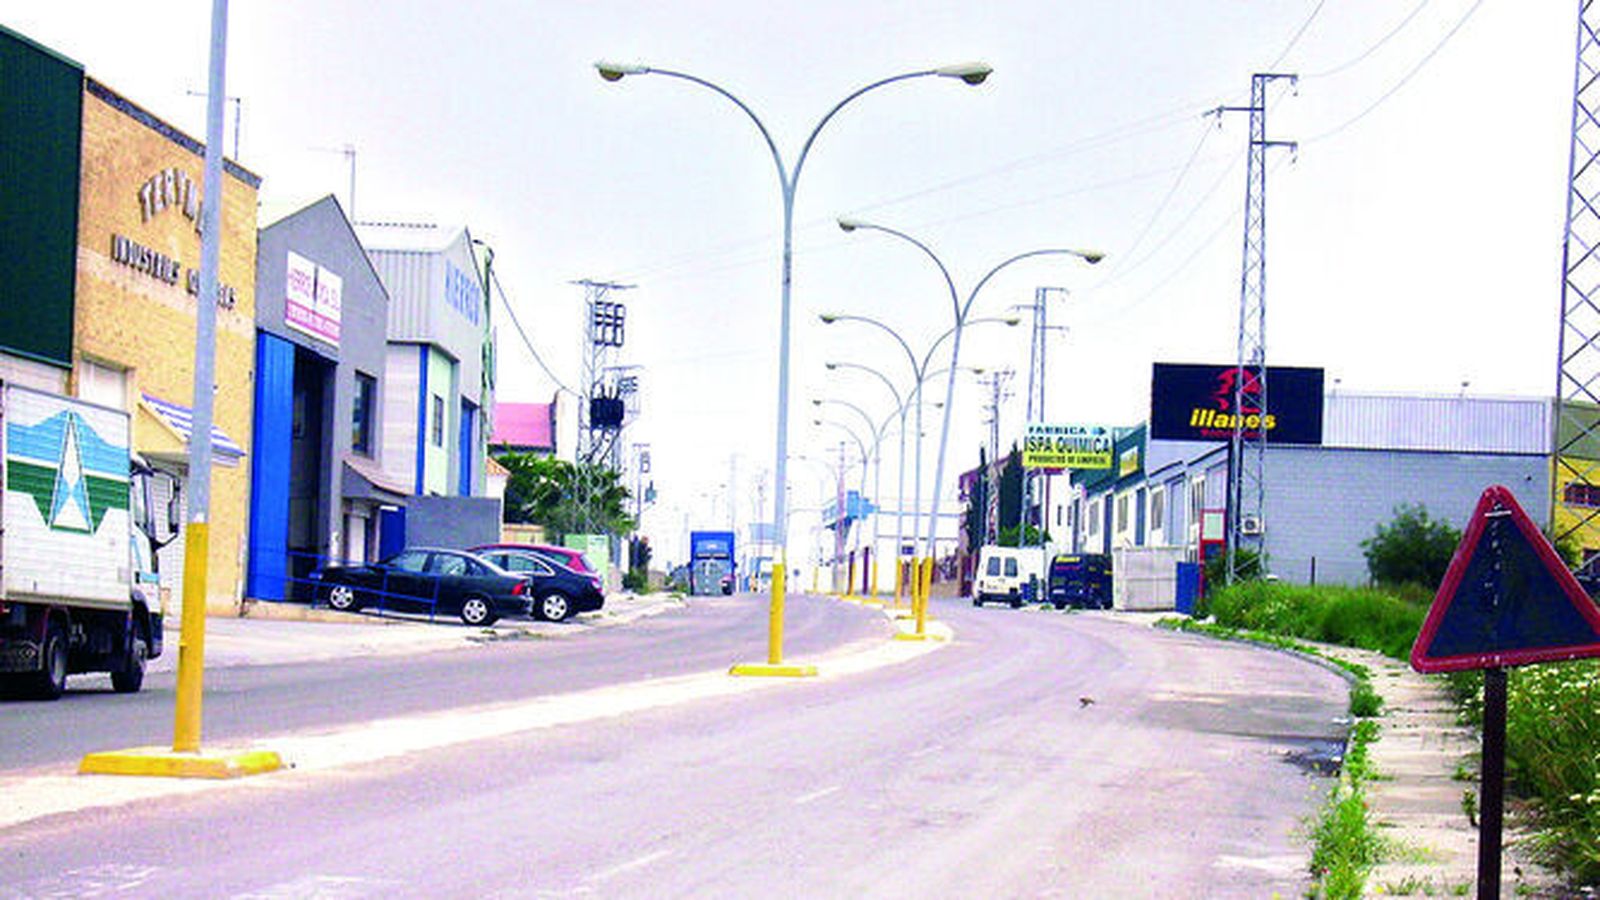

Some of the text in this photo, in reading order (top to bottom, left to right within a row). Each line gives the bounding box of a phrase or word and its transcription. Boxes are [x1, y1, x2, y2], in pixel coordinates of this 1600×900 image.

[1190, 408, 1277, 429] illanes
[1024, 436, 1110, 454] ISPA QUIMICA
